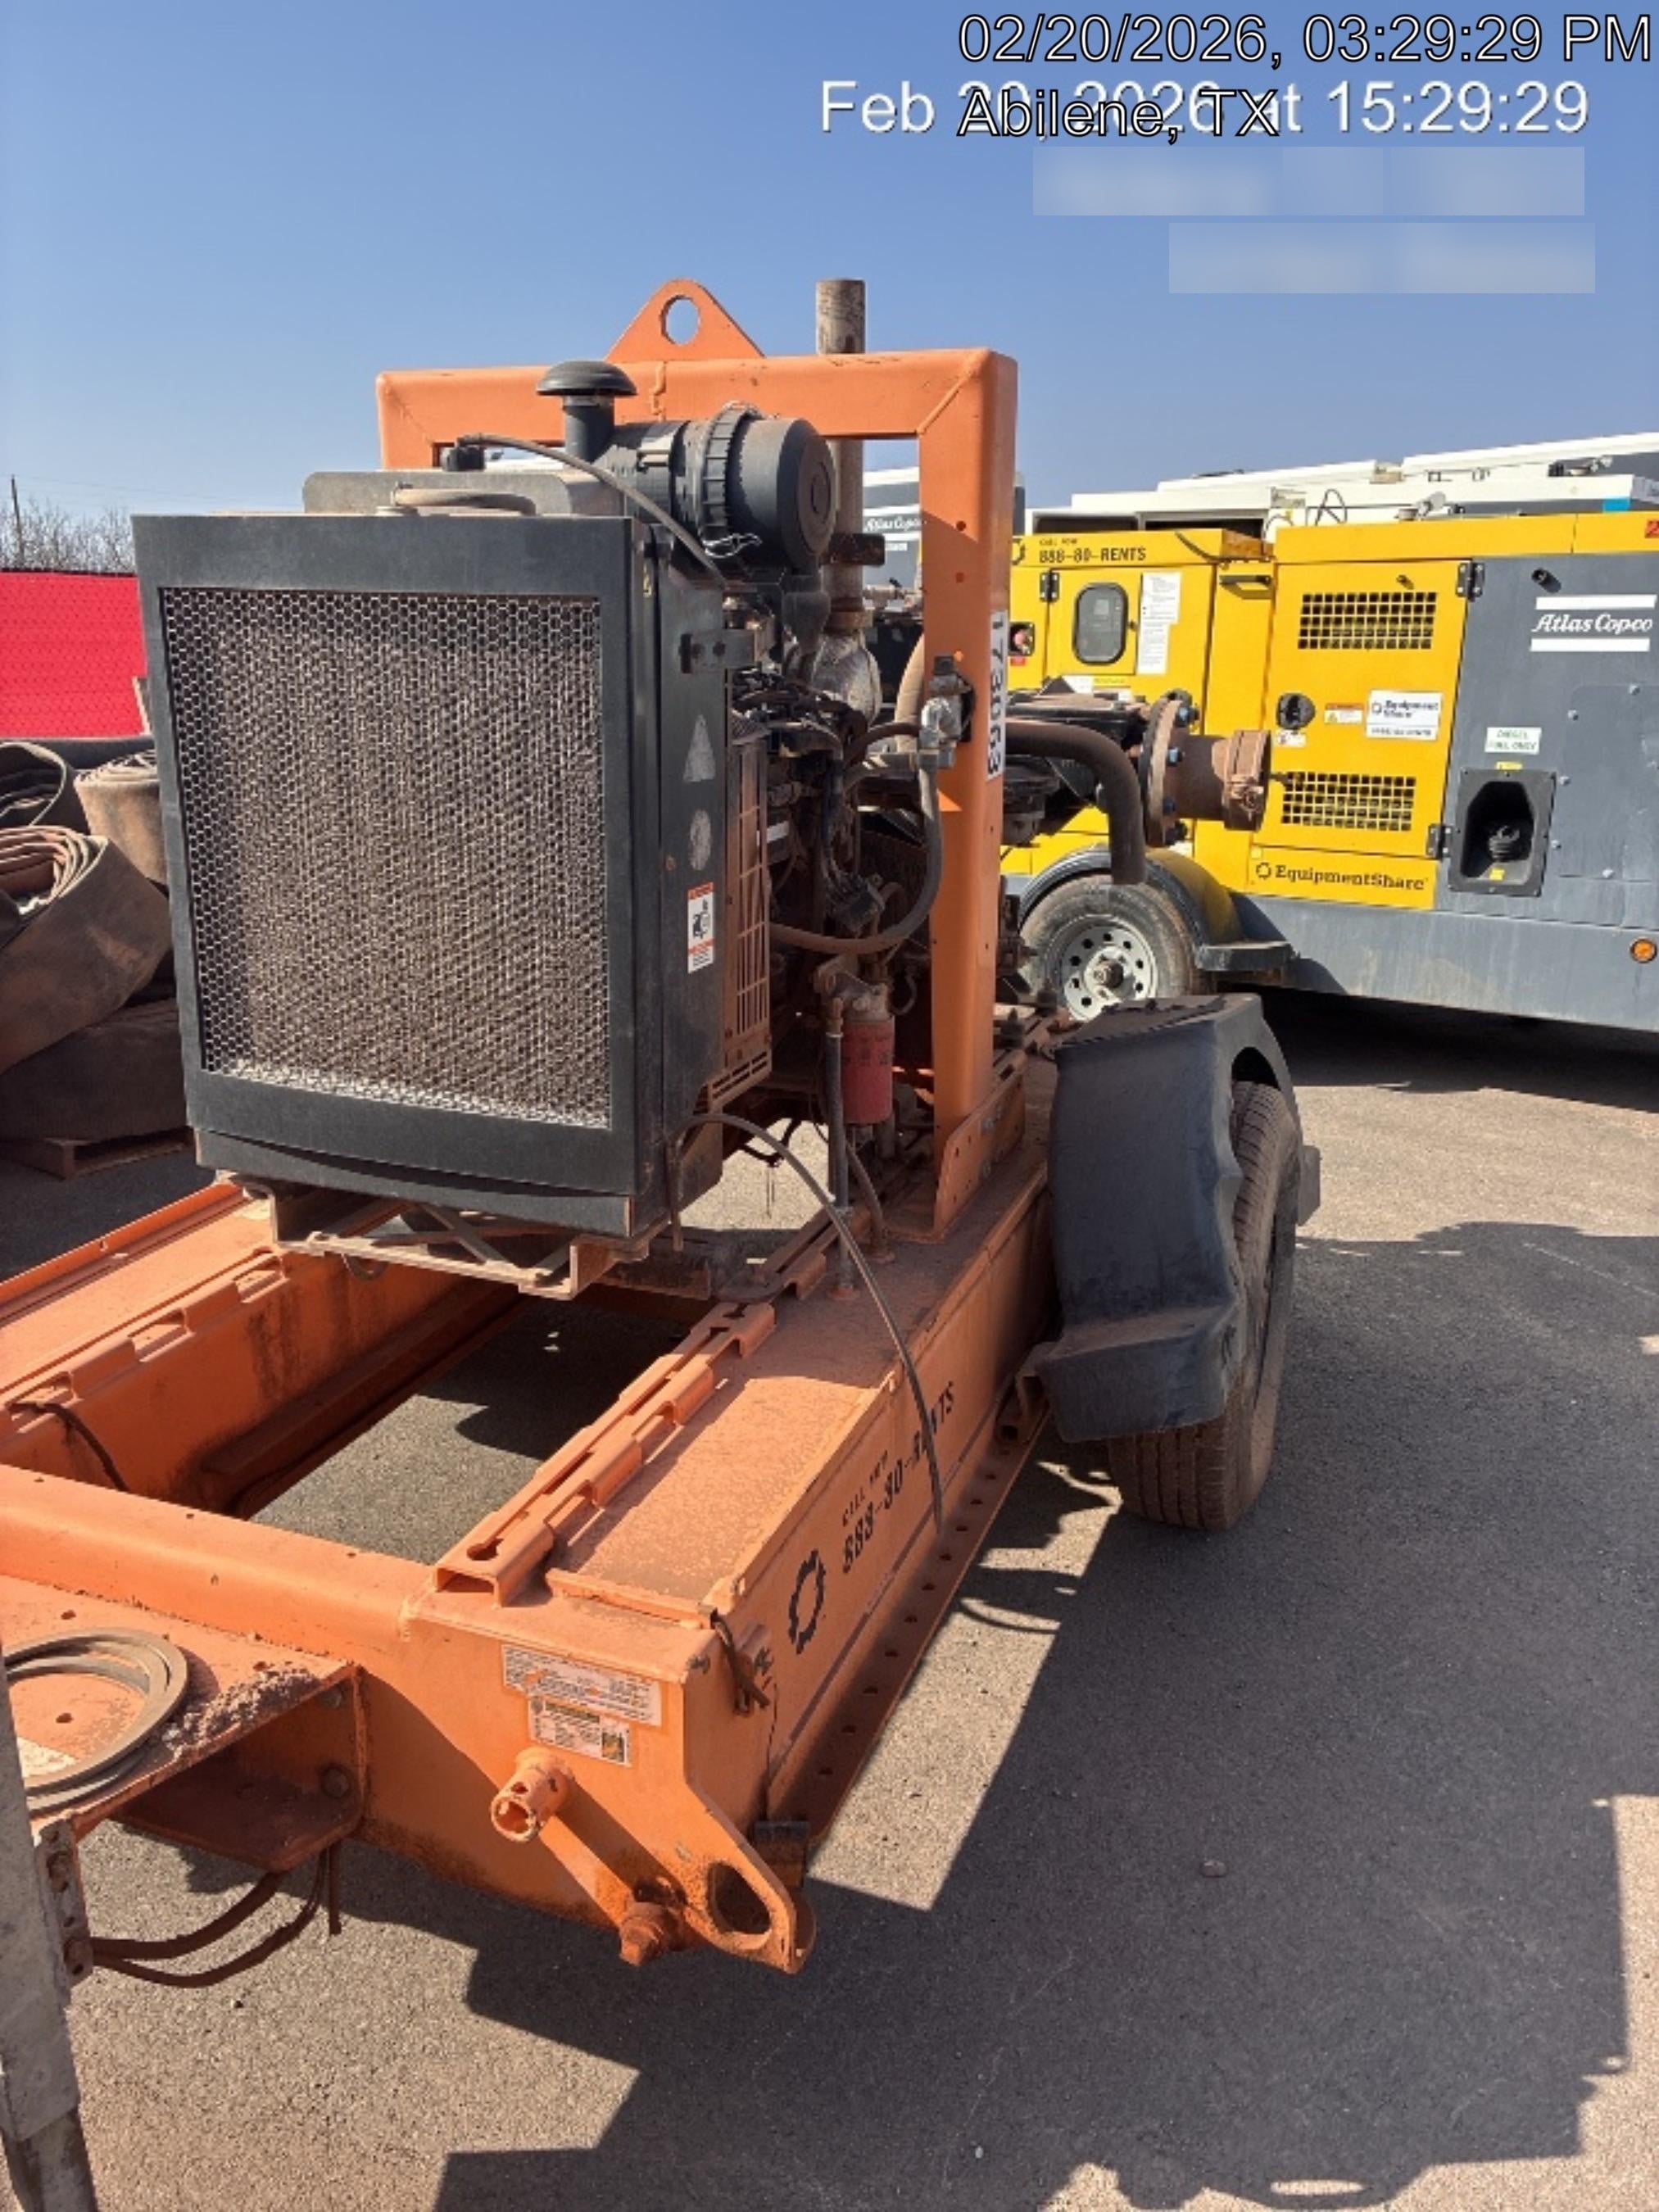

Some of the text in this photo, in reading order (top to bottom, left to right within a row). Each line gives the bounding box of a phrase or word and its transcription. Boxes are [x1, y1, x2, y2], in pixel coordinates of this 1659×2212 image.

[1531, 611, 1653, 636] Atlas Copco
[1275, 864, 1426, 891] EquipmentShare
